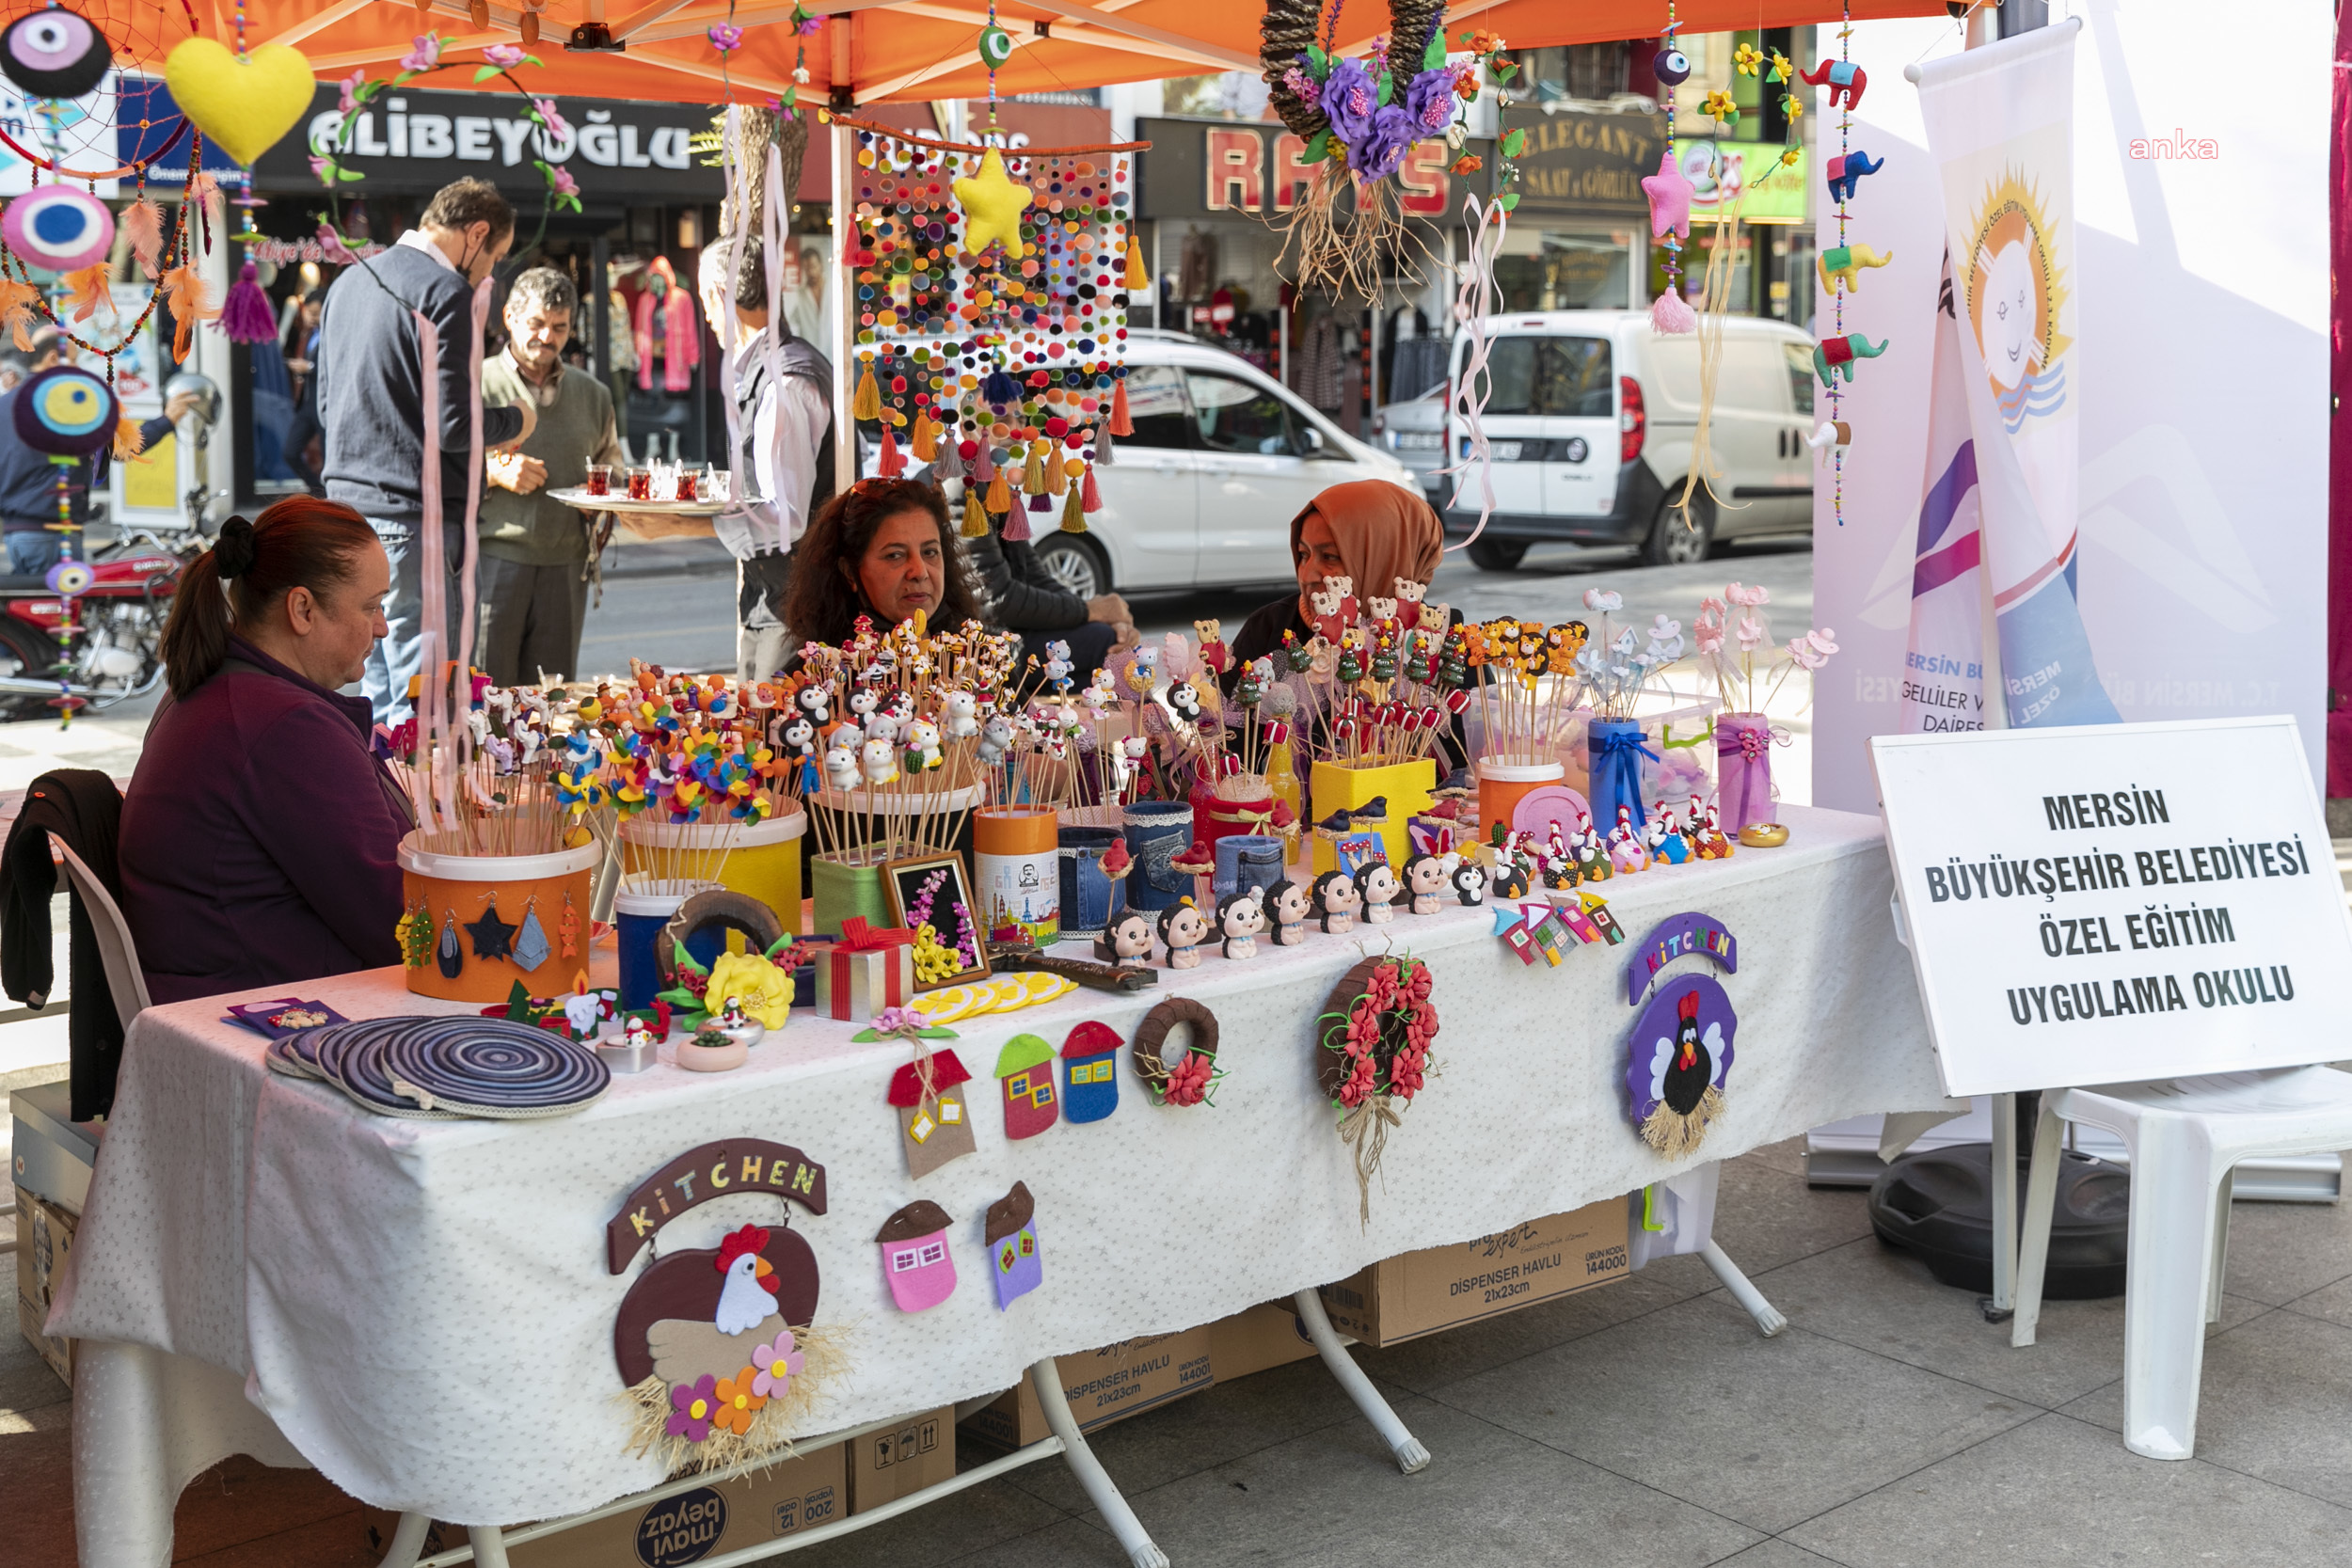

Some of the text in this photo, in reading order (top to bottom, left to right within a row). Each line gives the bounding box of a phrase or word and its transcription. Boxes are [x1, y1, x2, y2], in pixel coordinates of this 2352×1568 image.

[2040, 321, 2053, 372] KADEME
[1906, 649, 1961, 677] ERSİN
[2042, 784, 2170, 831] MERSİN
[1925, 833, 2311, 903] BÜYÜKŞEHİR BELEDİYESİ
[2039, 901, 2236, 958] ÖZEL EĞİTİM
[2007, 964, 2295, 1025] UYGULAMA OKULU
[1585, 1244, 1625, 1261] ÜRÜN KODU
[1586, 1254, 1627, 1275] 144000
[1450, 1253, 1561, 1296] DİSPENSER HAVLU
[1484, 1281, 1530, 1304] 21x23cm
[1132, 1354, 1169, 1378] HAVLU
[1179, 1363, 1211, 1385] 144001
[1096, 1384, 1140, 1407] 21x23cm
[646, 1497, 720, 1538] beyaz
[777, 1501, 798, 1515] adet
[781, 1513, 795, 1529] 12
[806, 1499, 833, 1521] 200
[654, 1520, 715, 1565] mavi
